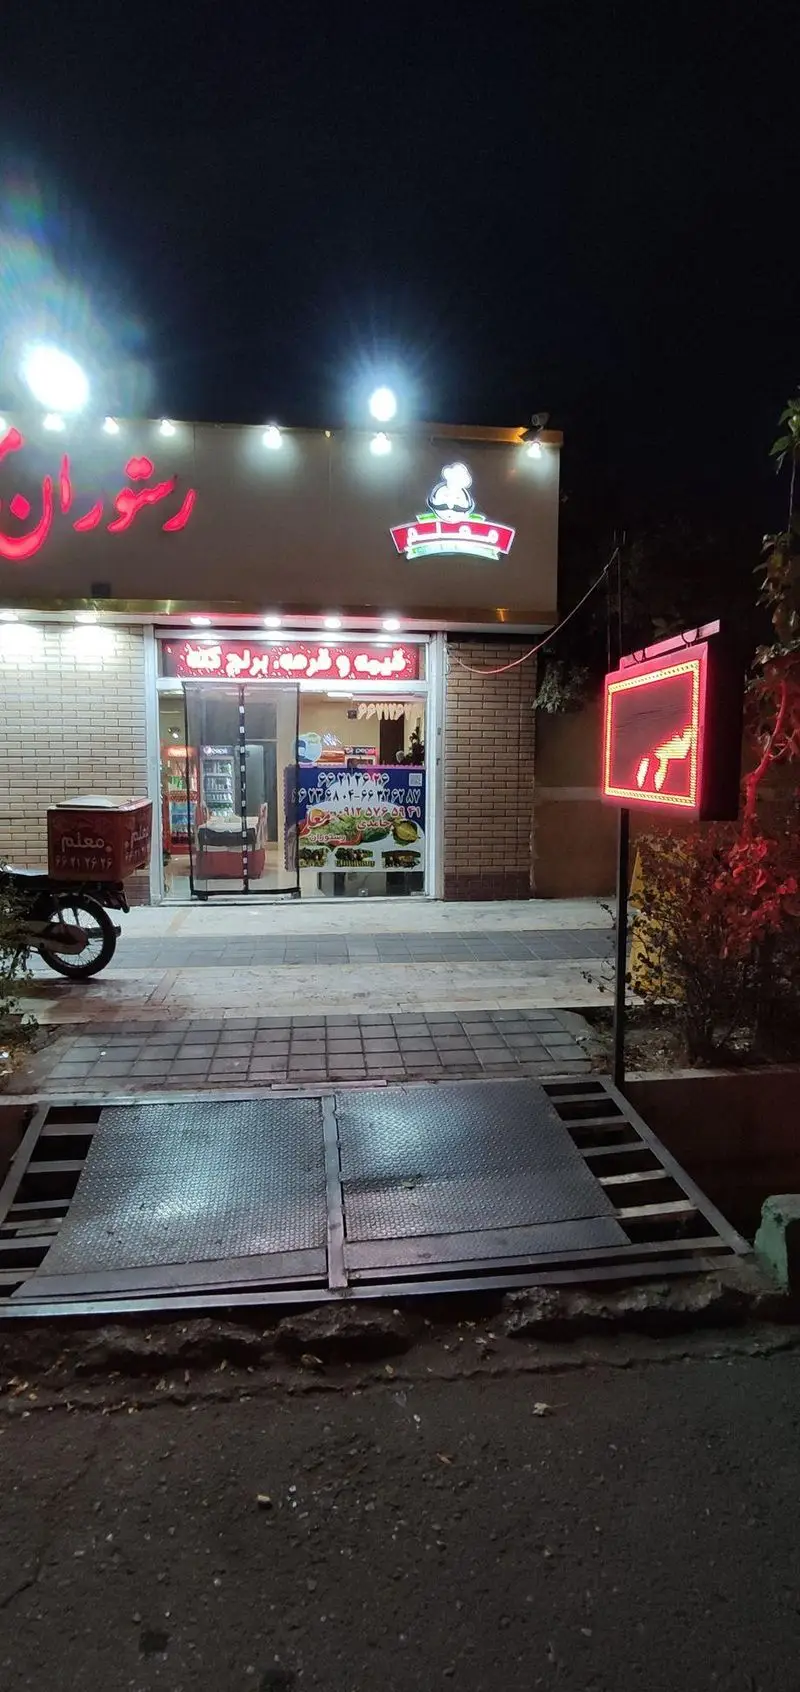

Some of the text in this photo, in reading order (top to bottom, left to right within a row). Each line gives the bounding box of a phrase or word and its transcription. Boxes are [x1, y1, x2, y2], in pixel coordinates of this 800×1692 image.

[0, 453, 197, 560] رستوران
[406, 521, 499, 547] معلم
[61, 832, 105, 853] معلم
[308, 833, 347, 843] رستوران
